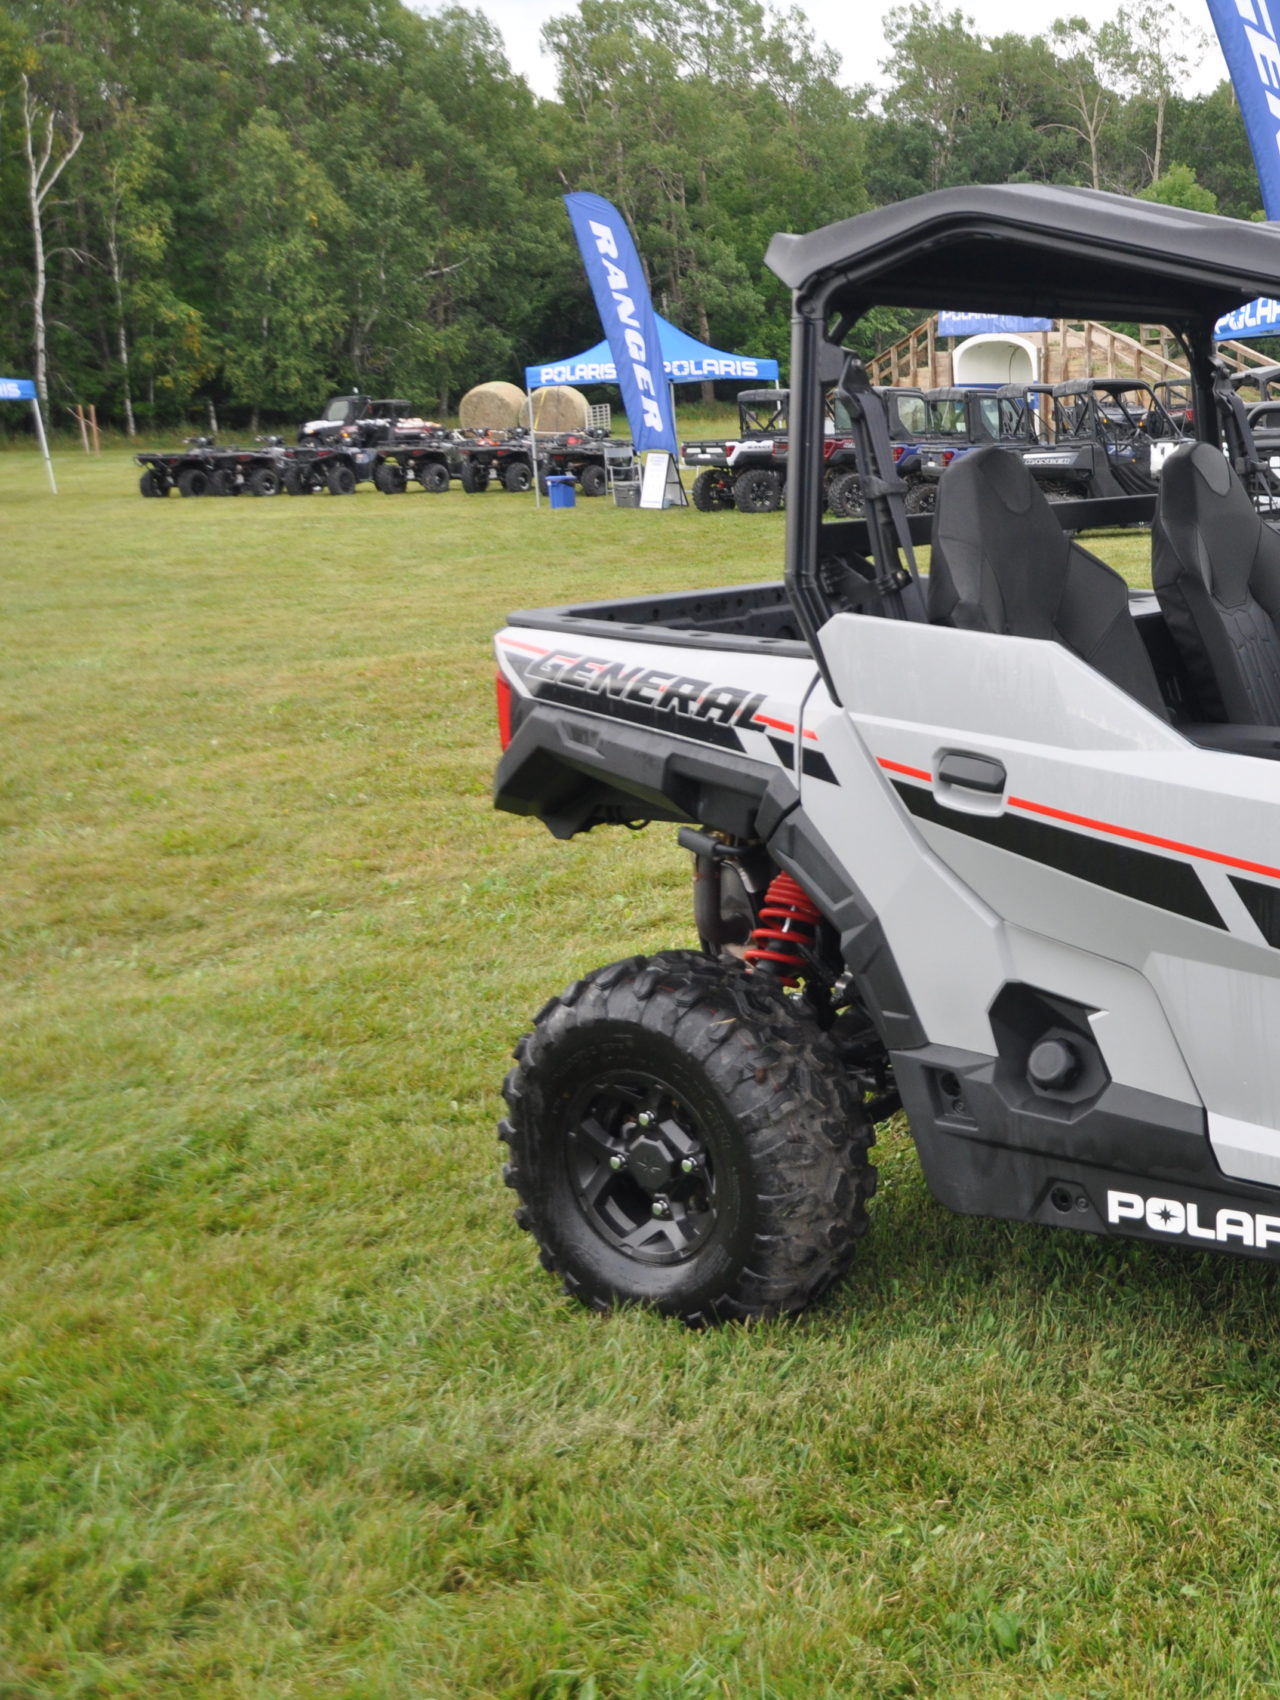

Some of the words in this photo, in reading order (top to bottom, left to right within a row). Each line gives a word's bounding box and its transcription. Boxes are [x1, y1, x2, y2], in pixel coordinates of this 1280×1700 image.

[588, 220, 664, 432] RANGER
[540, 363, 618, 384] POLARIS
[524, 650, 768, 733] GENERAL
